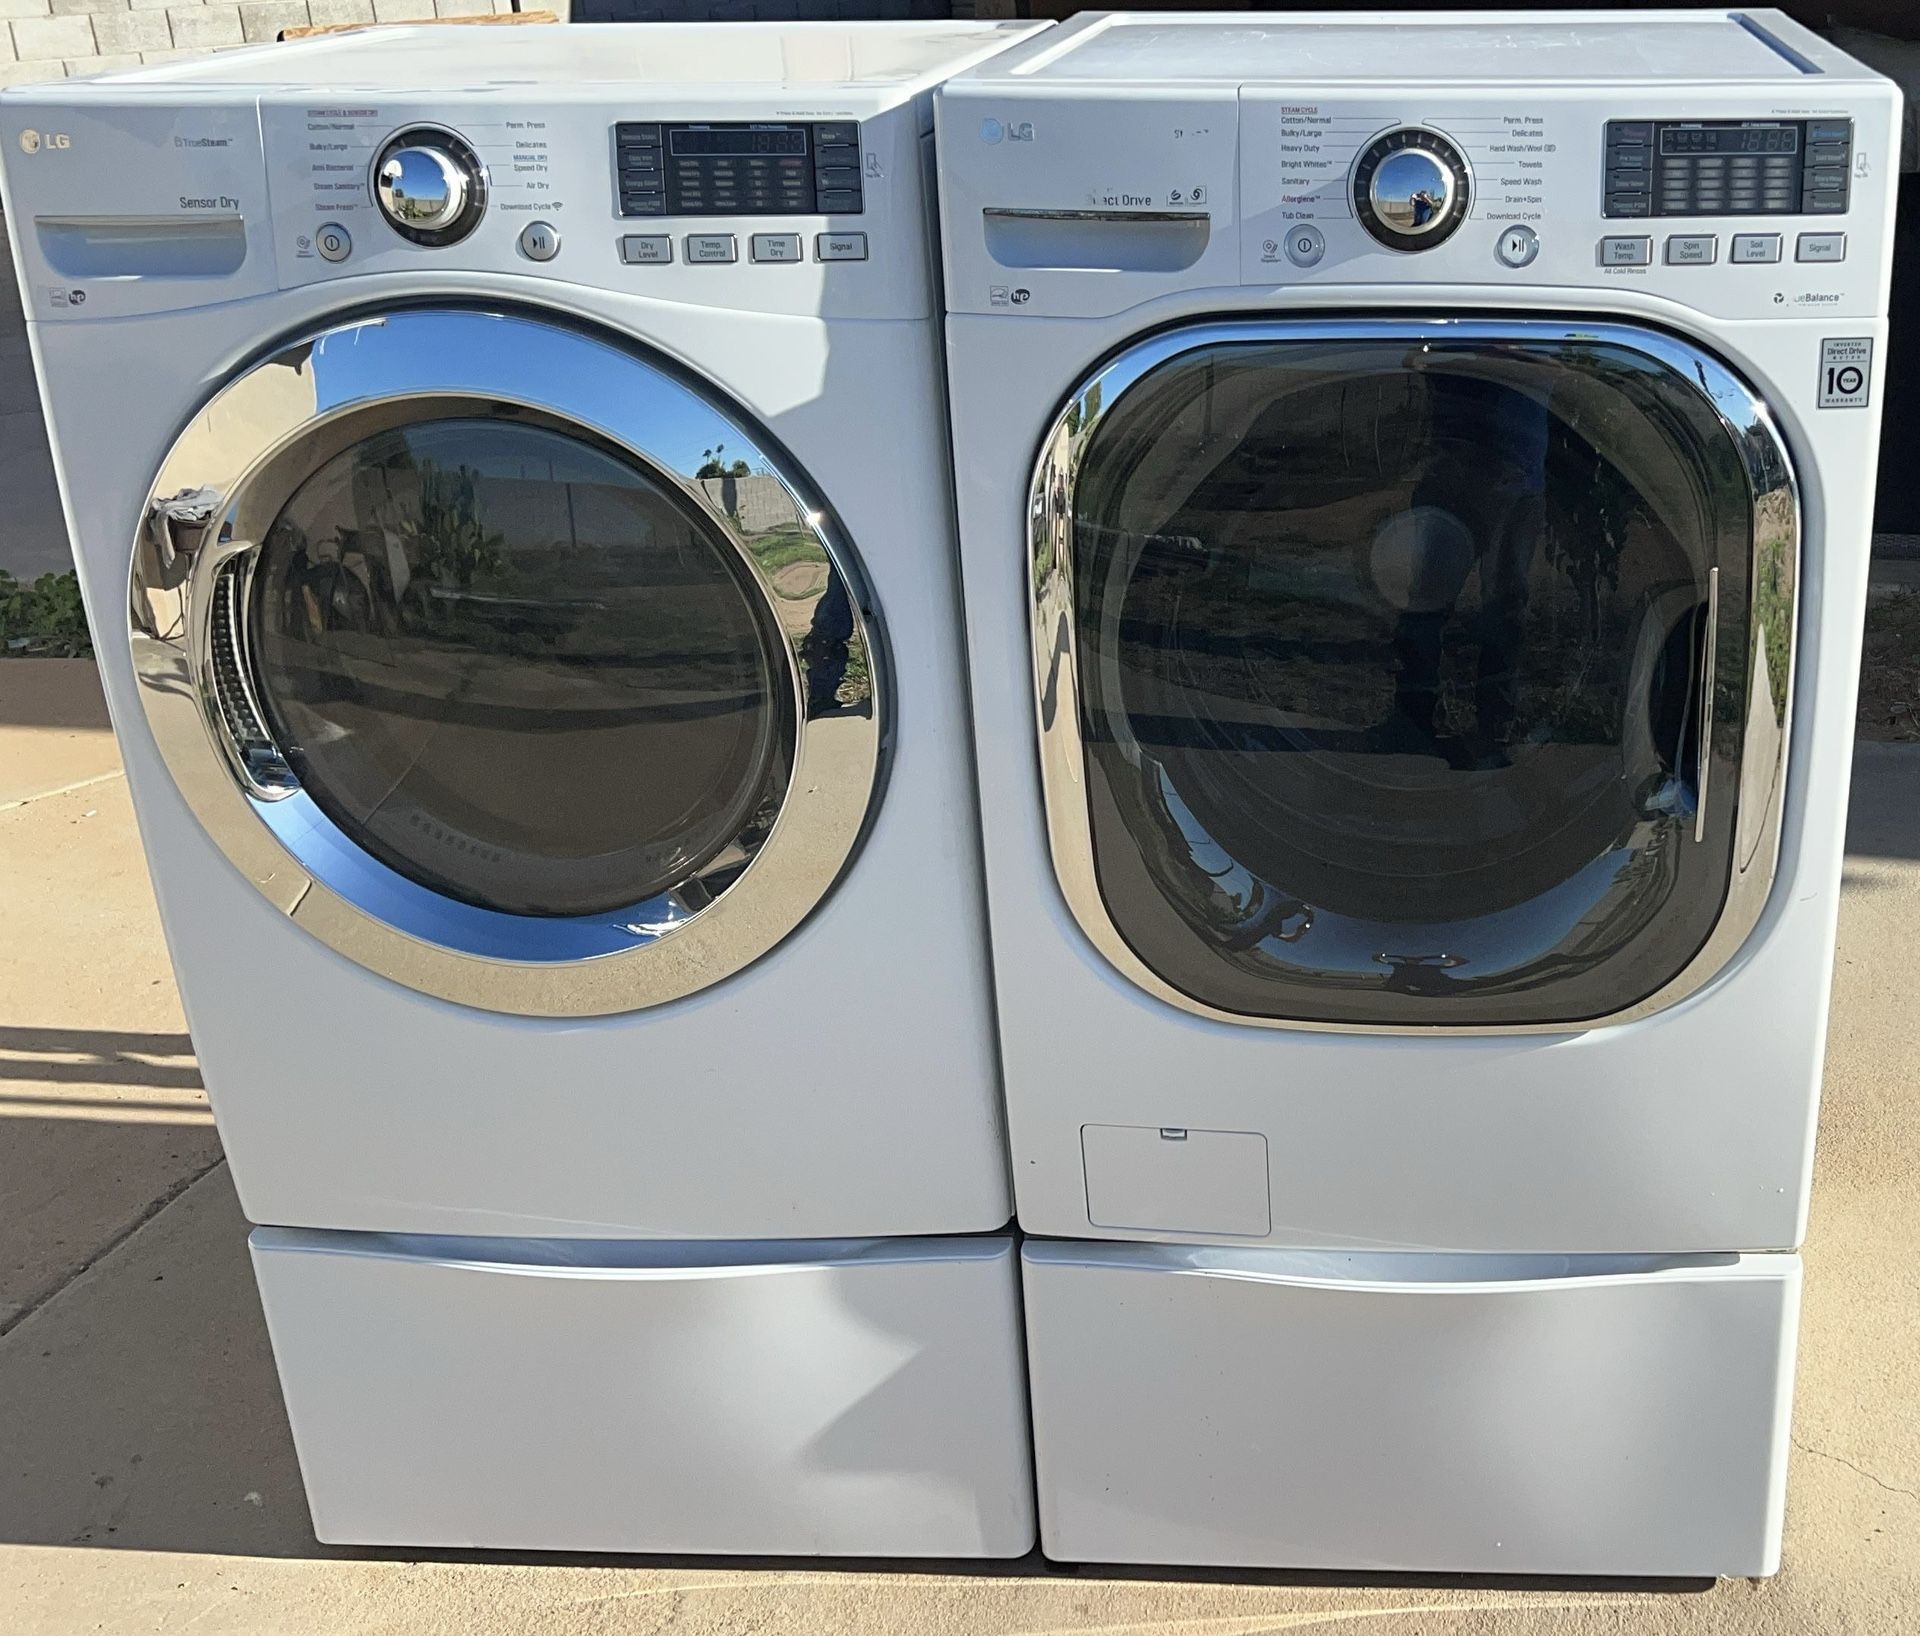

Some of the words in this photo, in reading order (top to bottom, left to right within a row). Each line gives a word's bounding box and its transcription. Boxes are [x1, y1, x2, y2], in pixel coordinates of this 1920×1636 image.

[1008, 123, 1034, 141] LG
[45, 134, 69, 149] LG
[1304, 145, 1320, 153] Duty
[1281, 161, 1301, 169] Bright
[537, 182, 550, 190] Dry
[1281, 178, 1310, 186] Sanitary
[1501, 178, 1522, 186] Speed
[1523, 178, 1543, 186] Wash
[179, 196, 216, 210] Sensor
[220, 196, 239, 210] Dry
[1122, 194, 1152, 207] Drive
[1282, 212, 1294, 220] Tub
[1295, 212, 1314, 220] Clean
[1487, 212, 1521, 220] Download
[1522, 212, 1542, 221] Cycle
[640, 242, 654, 252] Dry
[767, 240, 786, 249] Time
[830, 242, 853, 253] Signal
[1614, 242, 1635, 251] Wash
[1684, 241, 1700, 251] Spin
[1750, 240, 1764, 250] Soil
[1809, 243, 1832, 254] Signal
[639, 250, 659, 259] Level
[699, 249, 727, 258] Control
[770, 249, 784, 259] Dry
[1680, 249, 1703, 260] Speed
[1746, 249, 1766, 259] Level
[1827, 347, 1847, 355] Direct
[1827, 366, 1864, 395] 10
